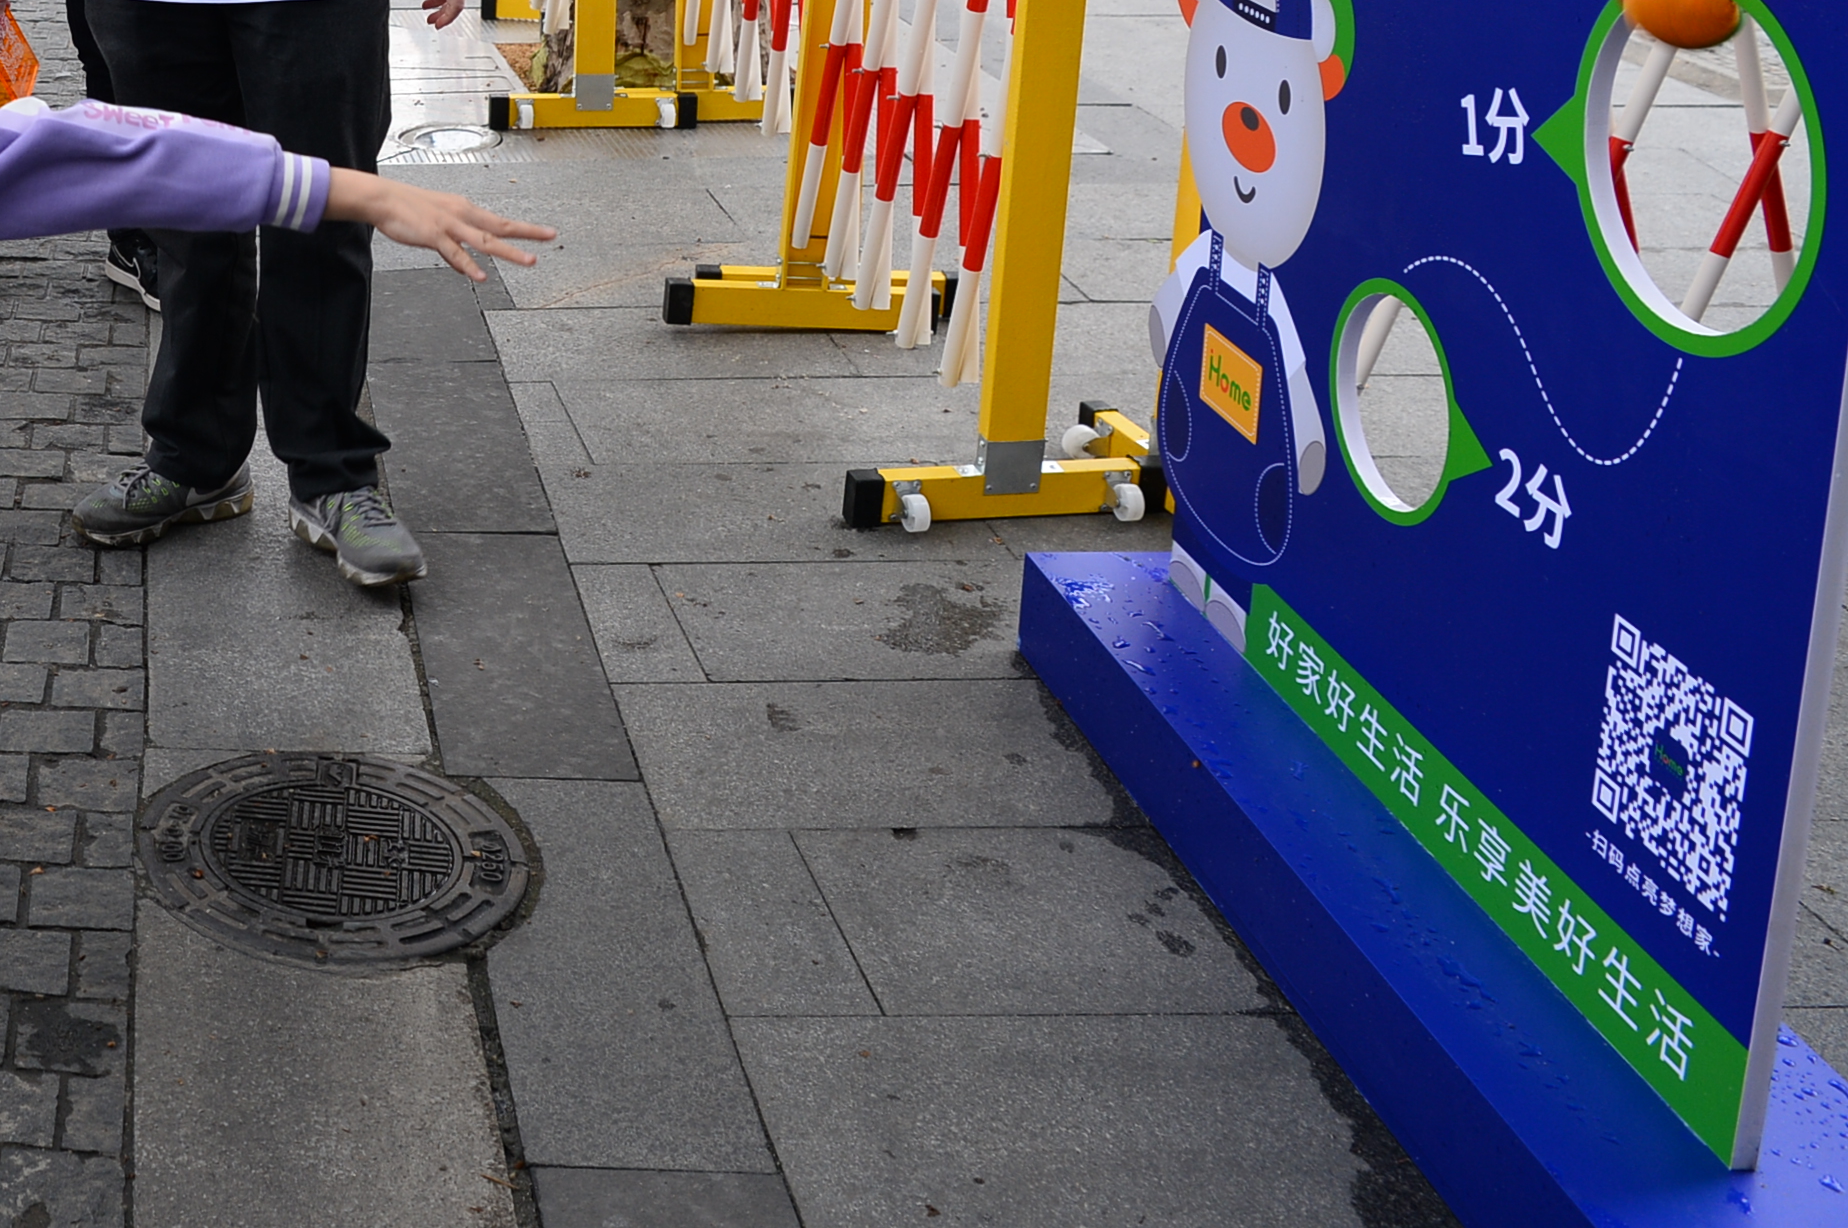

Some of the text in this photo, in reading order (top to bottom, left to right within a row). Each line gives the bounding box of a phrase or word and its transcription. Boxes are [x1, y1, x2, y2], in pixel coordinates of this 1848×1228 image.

[1461, 87, 1530, 165] 1分
[1208, 348, 1252, 412] Home
[1494, 448, 1572, 549] 2分
[1266, 610, 1694, 1082] 好家好生活 乐享美好生活
